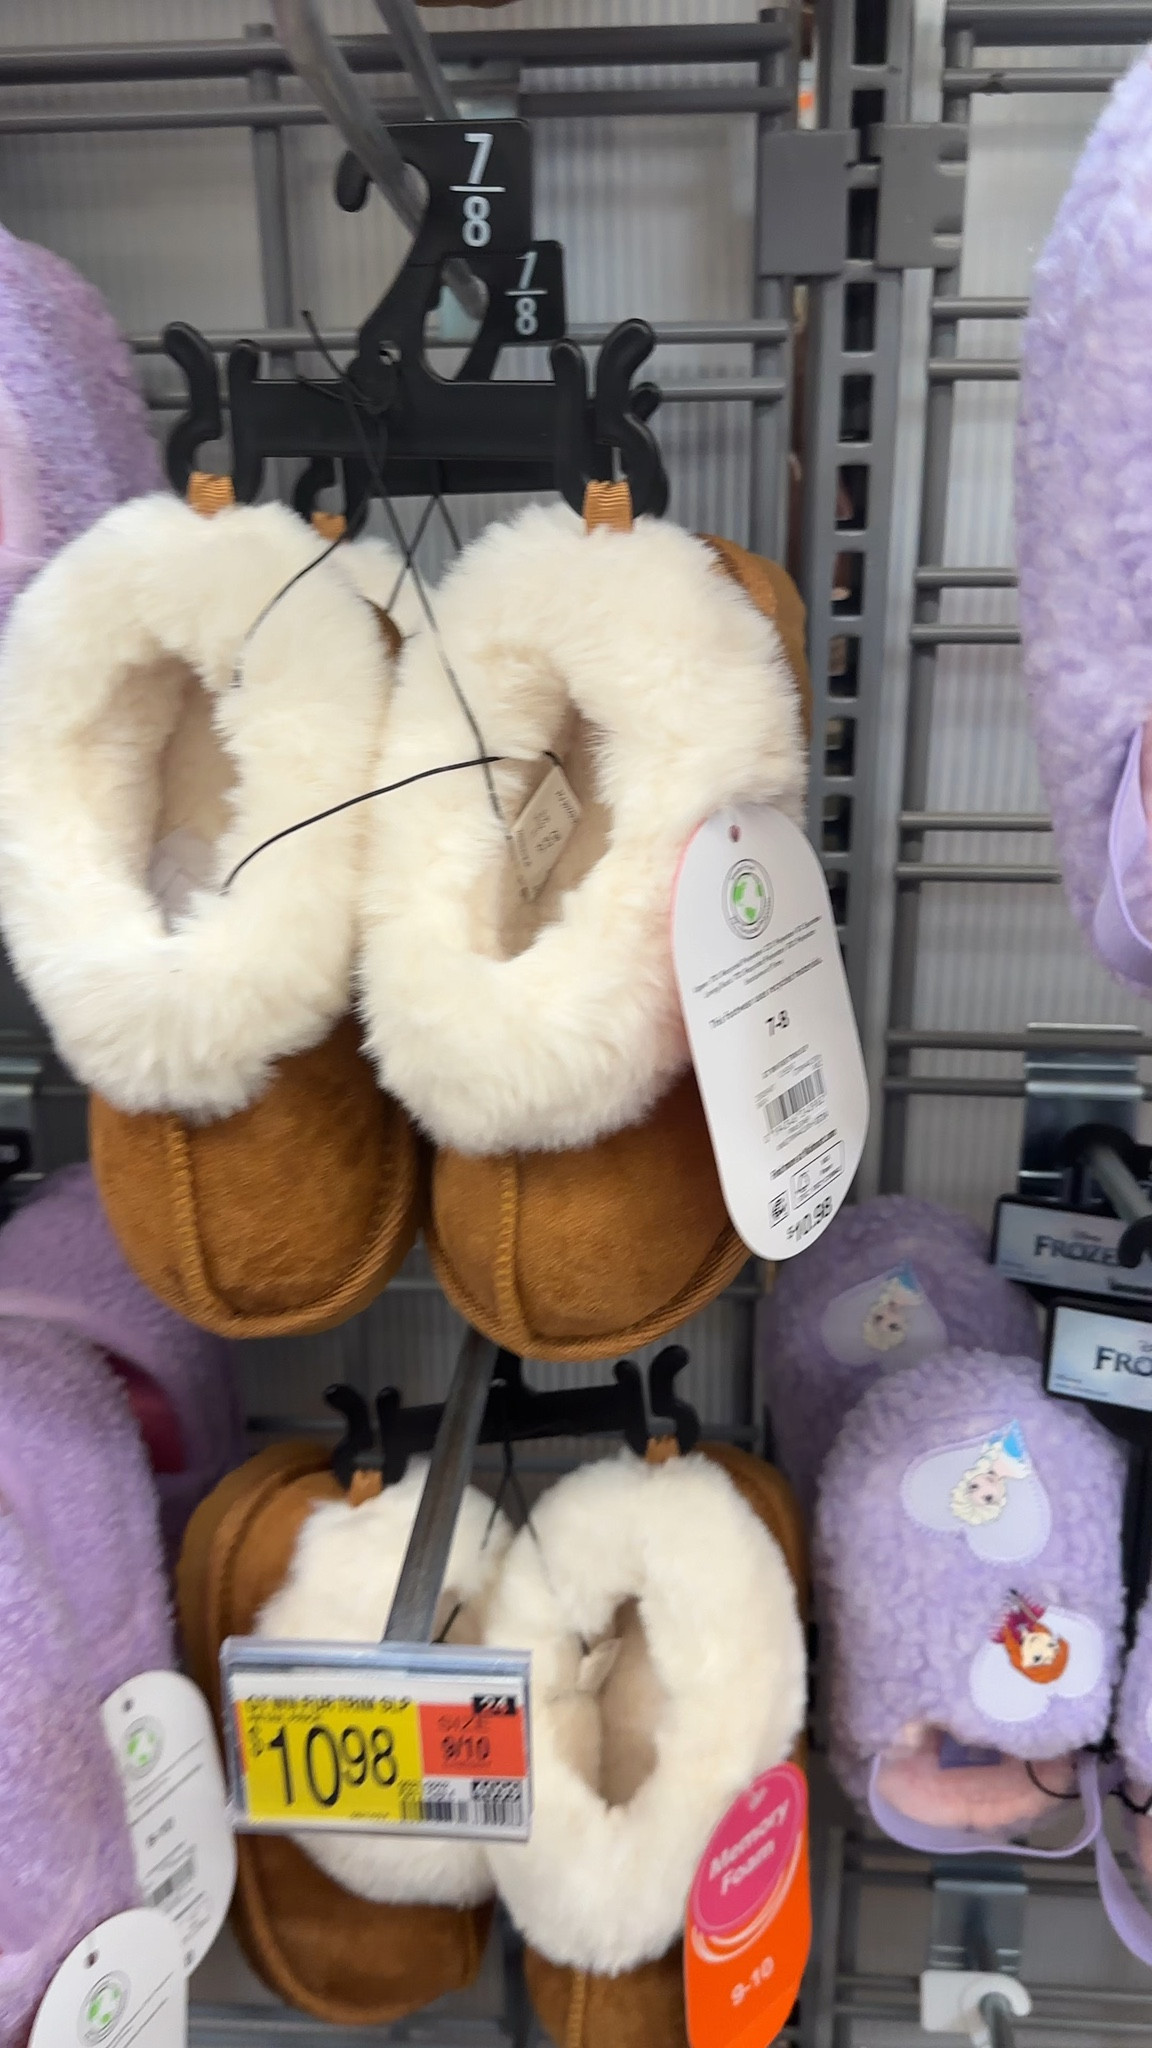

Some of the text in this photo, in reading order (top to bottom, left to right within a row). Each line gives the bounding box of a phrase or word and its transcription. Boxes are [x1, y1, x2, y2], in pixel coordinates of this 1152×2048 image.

[464, 132, 494, 184] 7
[462, 195, 491, 247] 8
[515, 297, 538, 335] 8
[1033, 1234, 1121, 1267] FROZE
[730, 1956, 775, 2007] 9-10
